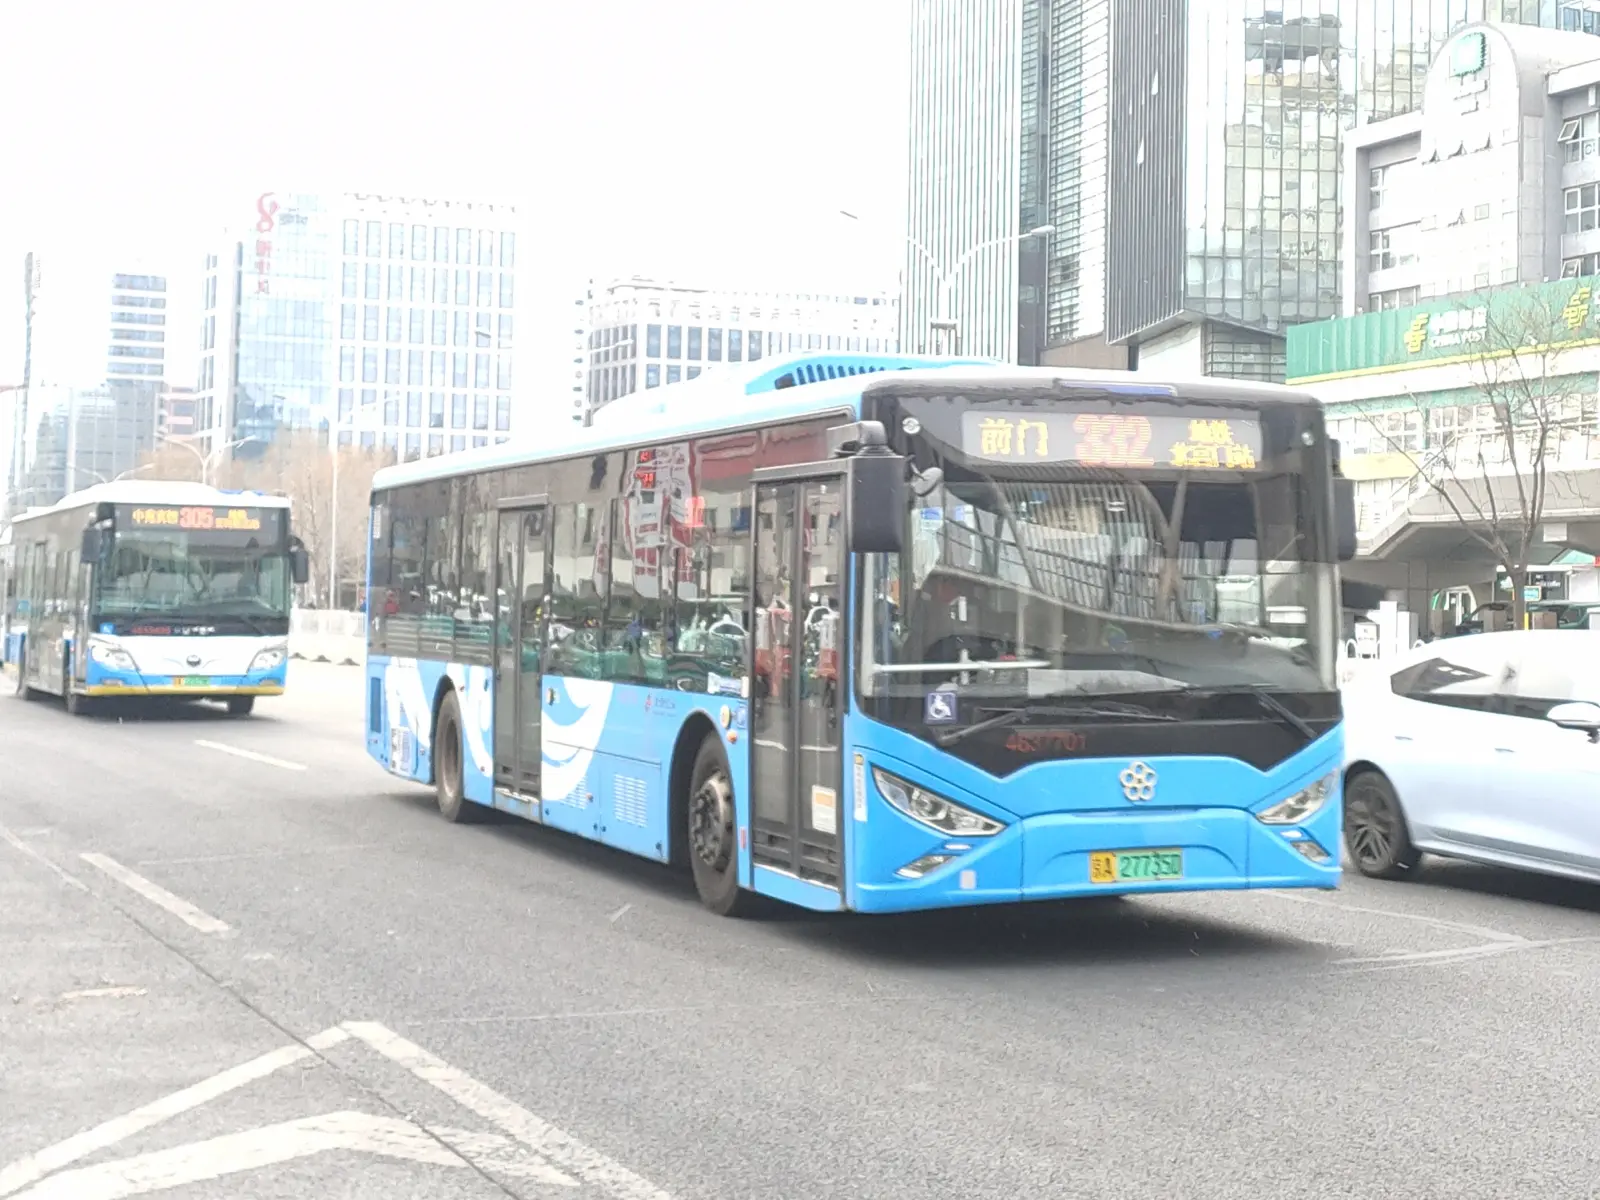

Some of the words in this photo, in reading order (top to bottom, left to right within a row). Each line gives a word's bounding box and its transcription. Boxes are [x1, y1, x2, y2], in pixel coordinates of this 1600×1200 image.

[978, 418, 1048, 456] 前门
[1073, 413, 1154, 467] 332
[180, 507, 214, 529] 305
